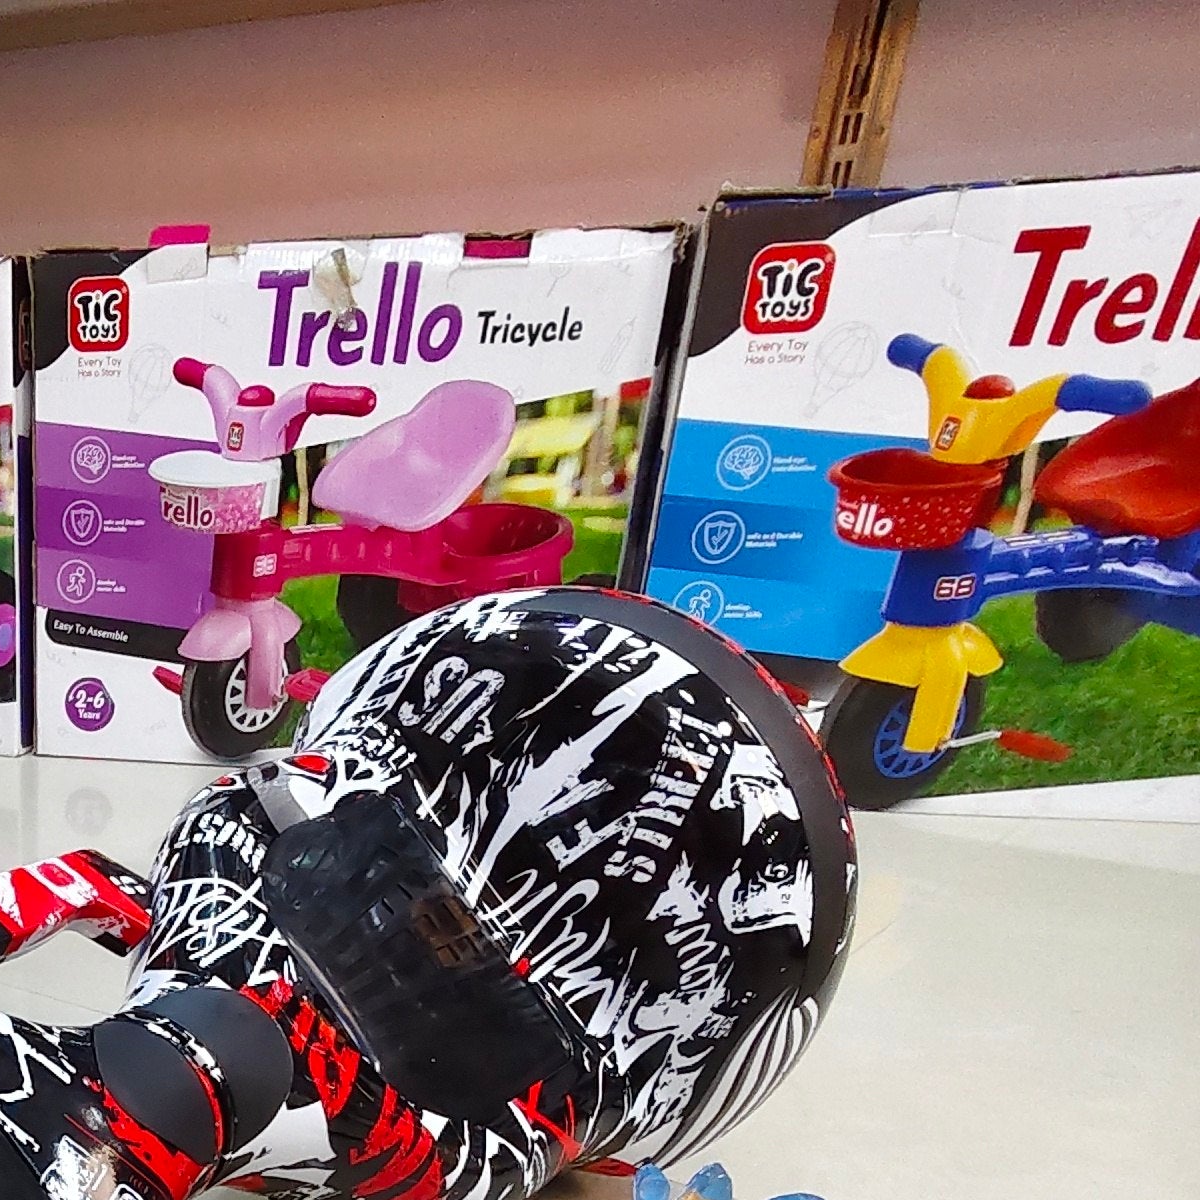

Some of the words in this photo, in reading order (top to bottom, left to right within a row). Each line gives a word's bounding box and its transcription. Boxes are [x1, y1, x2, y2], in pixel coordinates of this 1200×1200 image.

[257, 261, 463, 367] Trello
[477, 306, 583, 347] Tricycle
[748, 341, 783, 353] Every
[788, 338, 809, 352] Toy
[53, 619, 74, 634] Easy
[75, 623, 86, 634] To
[86, 626, 129, 642] Assemble
[75, 689, 105, 709] 2-6
[78, 708, 101, 720] Years
